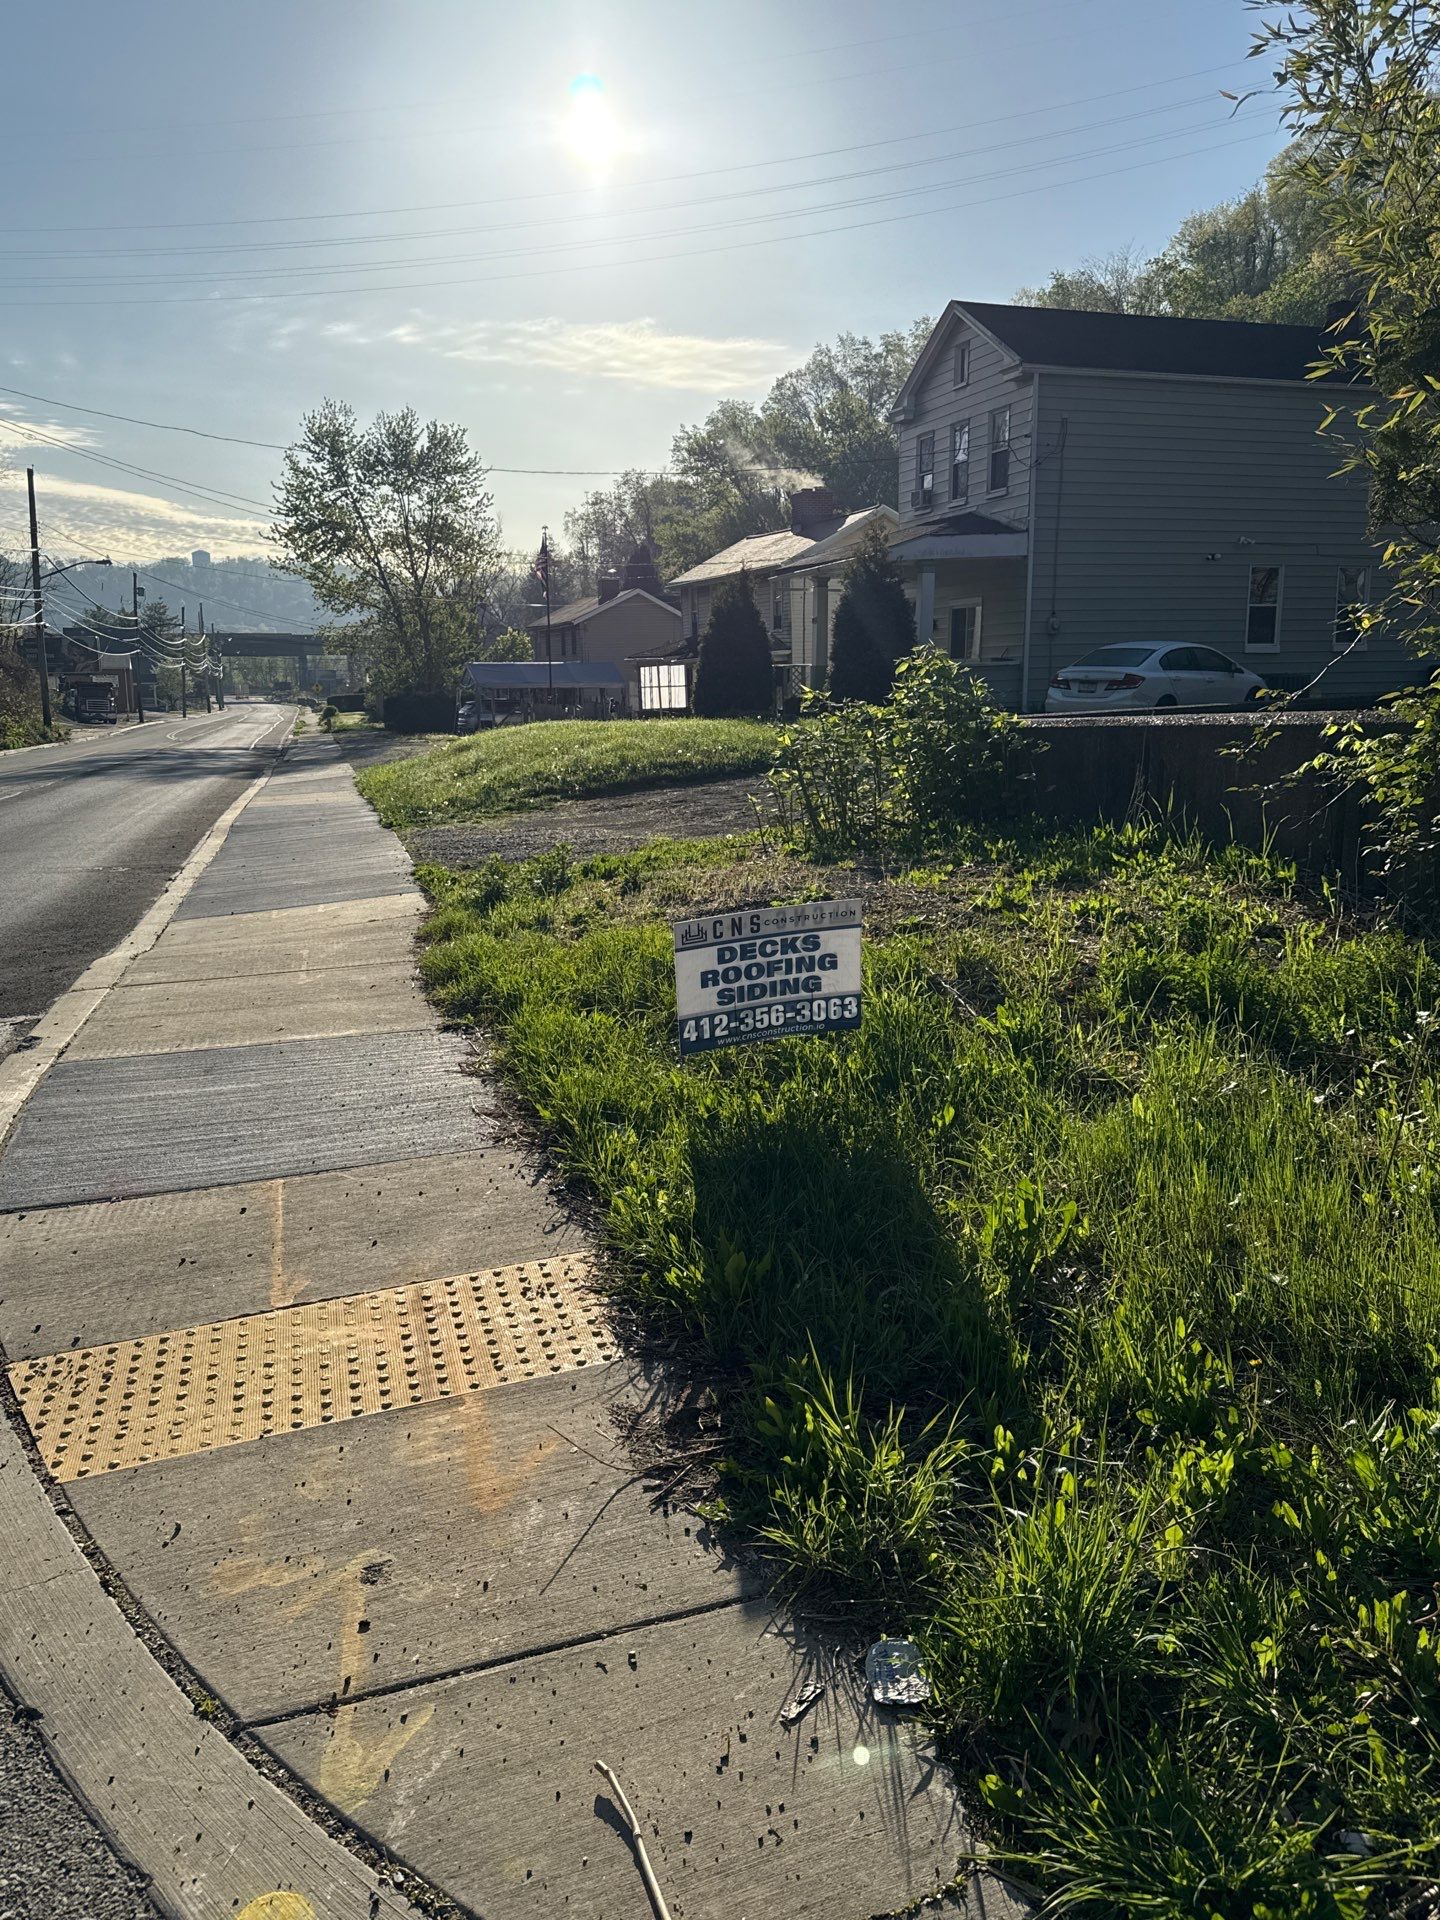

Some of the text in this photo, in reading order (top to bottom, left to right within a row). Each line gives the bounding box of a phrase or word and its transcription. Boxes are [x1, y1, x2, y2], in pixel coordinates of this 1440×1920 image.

[713, 909, 857, 939] CNS CONSTRUCTION
[717, 934, 821, 965] DECKS
[700, 953, 838, 989] ROOFING
[716, 975, 822, 1006] SIDING
[683, 996, 858, 1042] 412-356-3063
[717, 1022, 825, 1046] www.cnsconstruction.io
